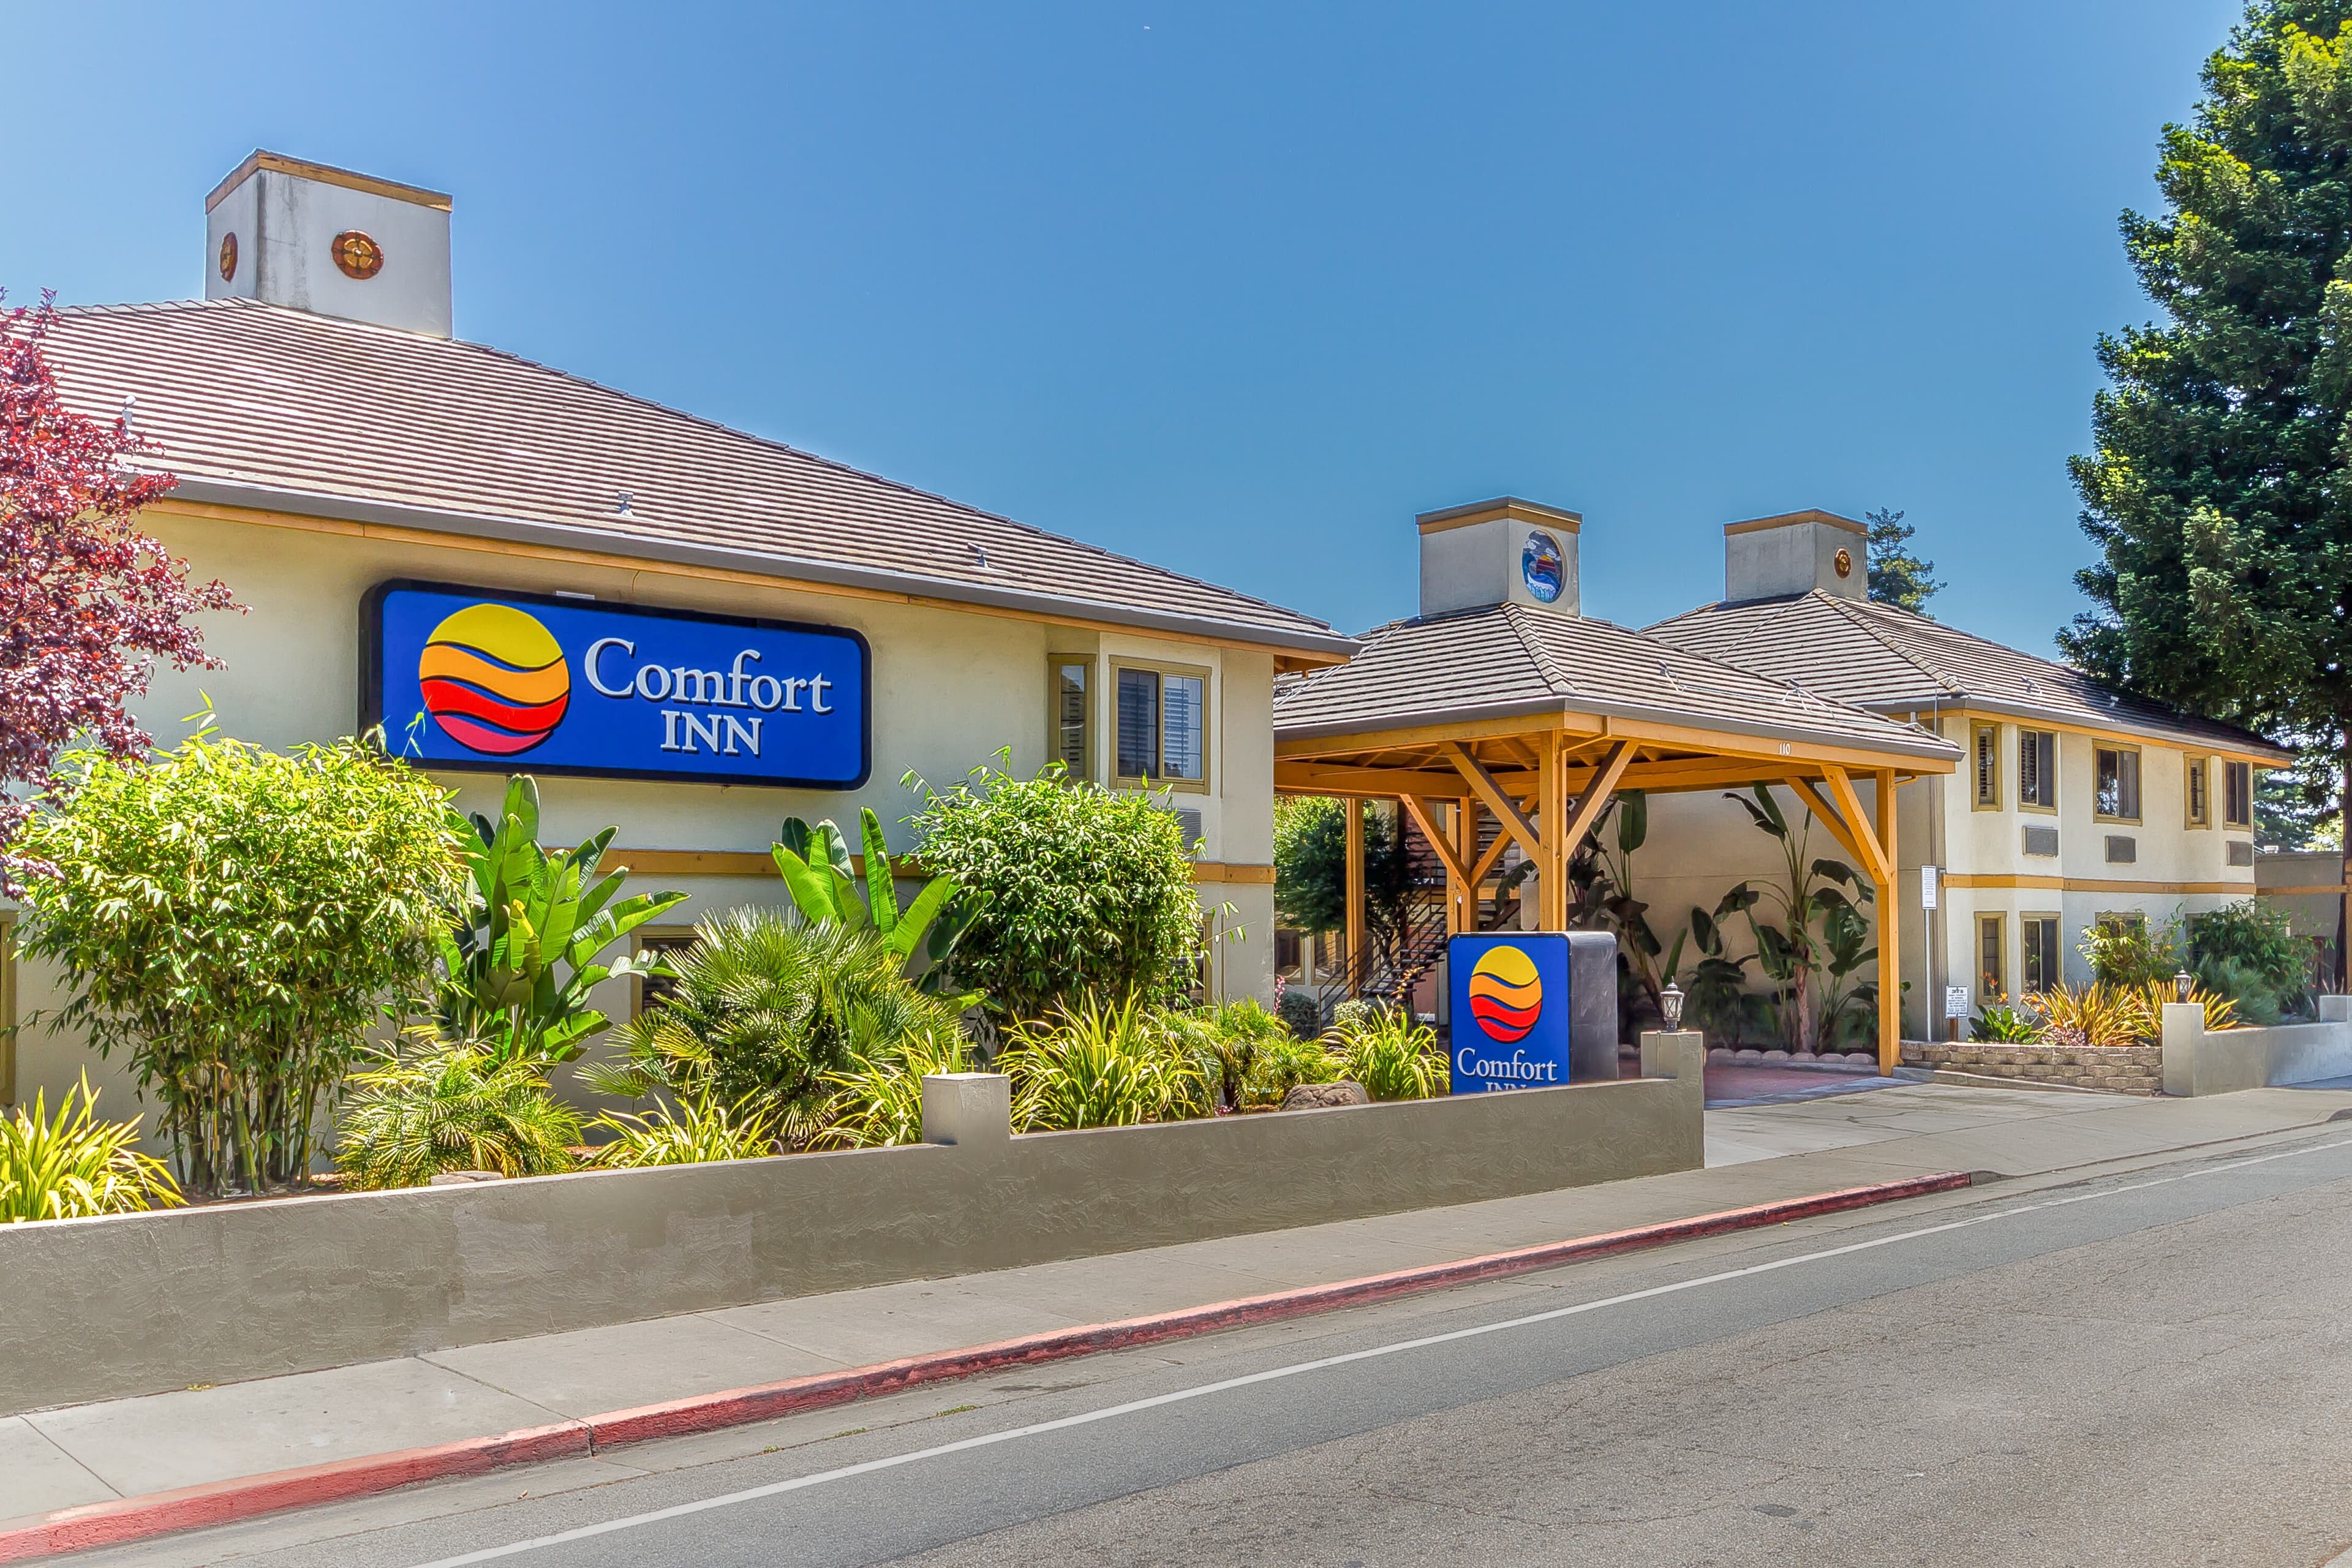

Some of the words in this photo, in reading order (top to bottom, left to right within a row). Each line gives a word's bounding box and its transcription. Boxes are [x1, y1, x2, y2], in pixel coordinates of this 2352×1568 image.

[585, 638, 832, 712] Comfort
[660, 710, 763, 756] INN
[1779, 743, 1791, 755] 110
[1457, 1047, 1558, 1081] Comfort
[1485, 1082, 1527, 1092] IN
